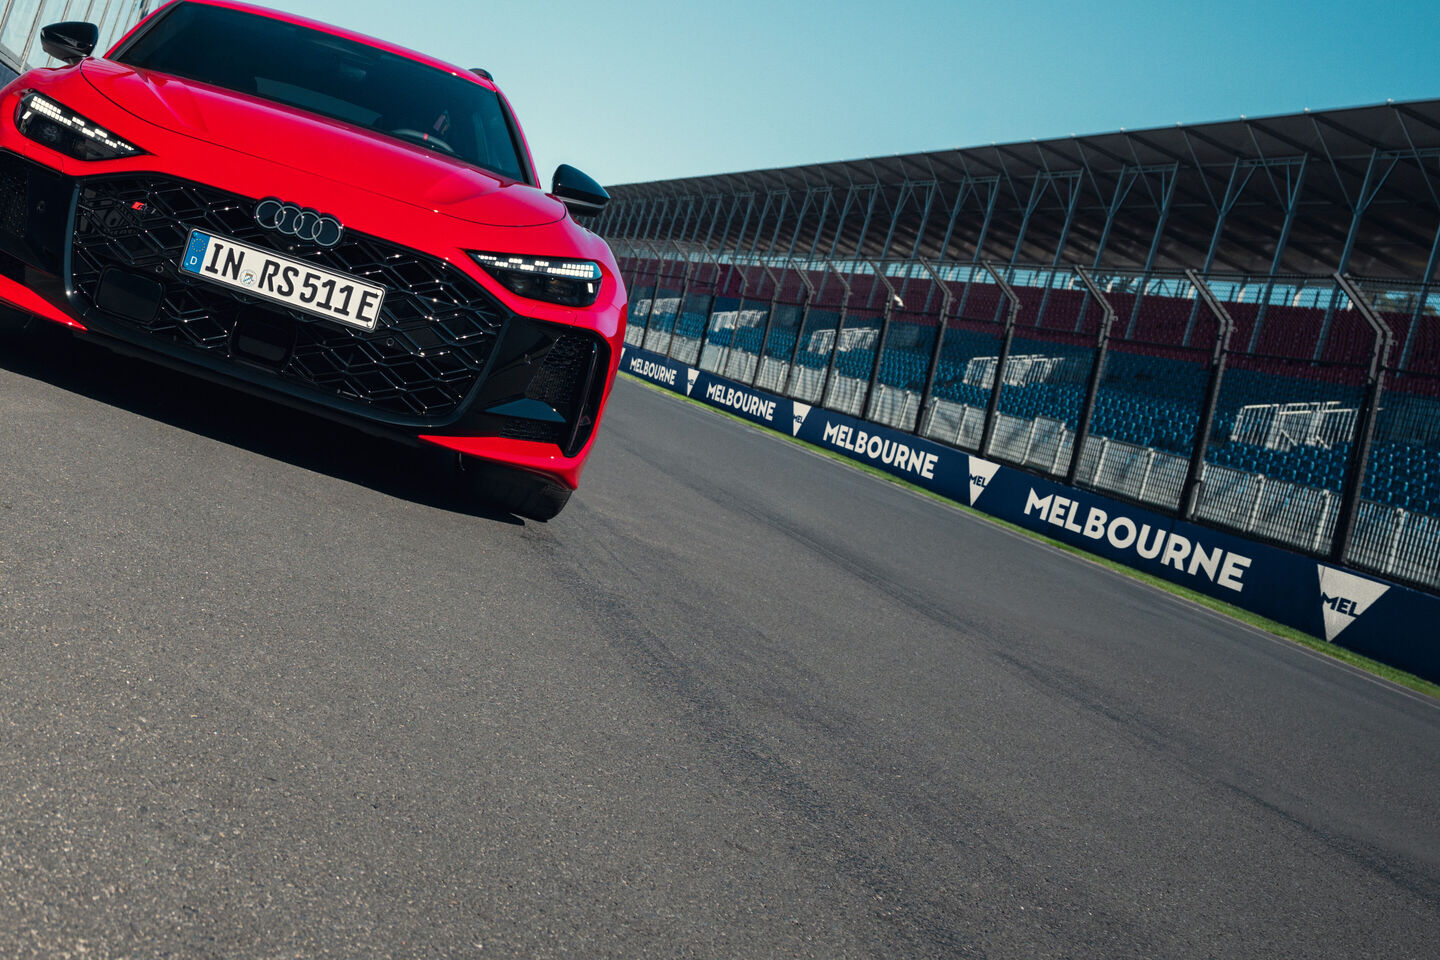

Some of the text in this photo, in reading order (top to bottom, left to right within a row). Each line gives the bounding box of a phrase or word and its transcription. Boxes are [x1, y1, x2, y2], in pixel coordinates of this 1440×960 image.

[189, 255, 198, 265] D
[205, 243, 246, 281] IN
[629, 357, 677, 386] MELBOURNE
[706, 381, 776, 421] MELBOURNE
[823, 420, 939, 480] MELBOURNE
[969, 472, 987, 488] MEL
[1023, 487, 1252, 593] MELBOURNE
[1321, 591, 1360, 618] MEL
